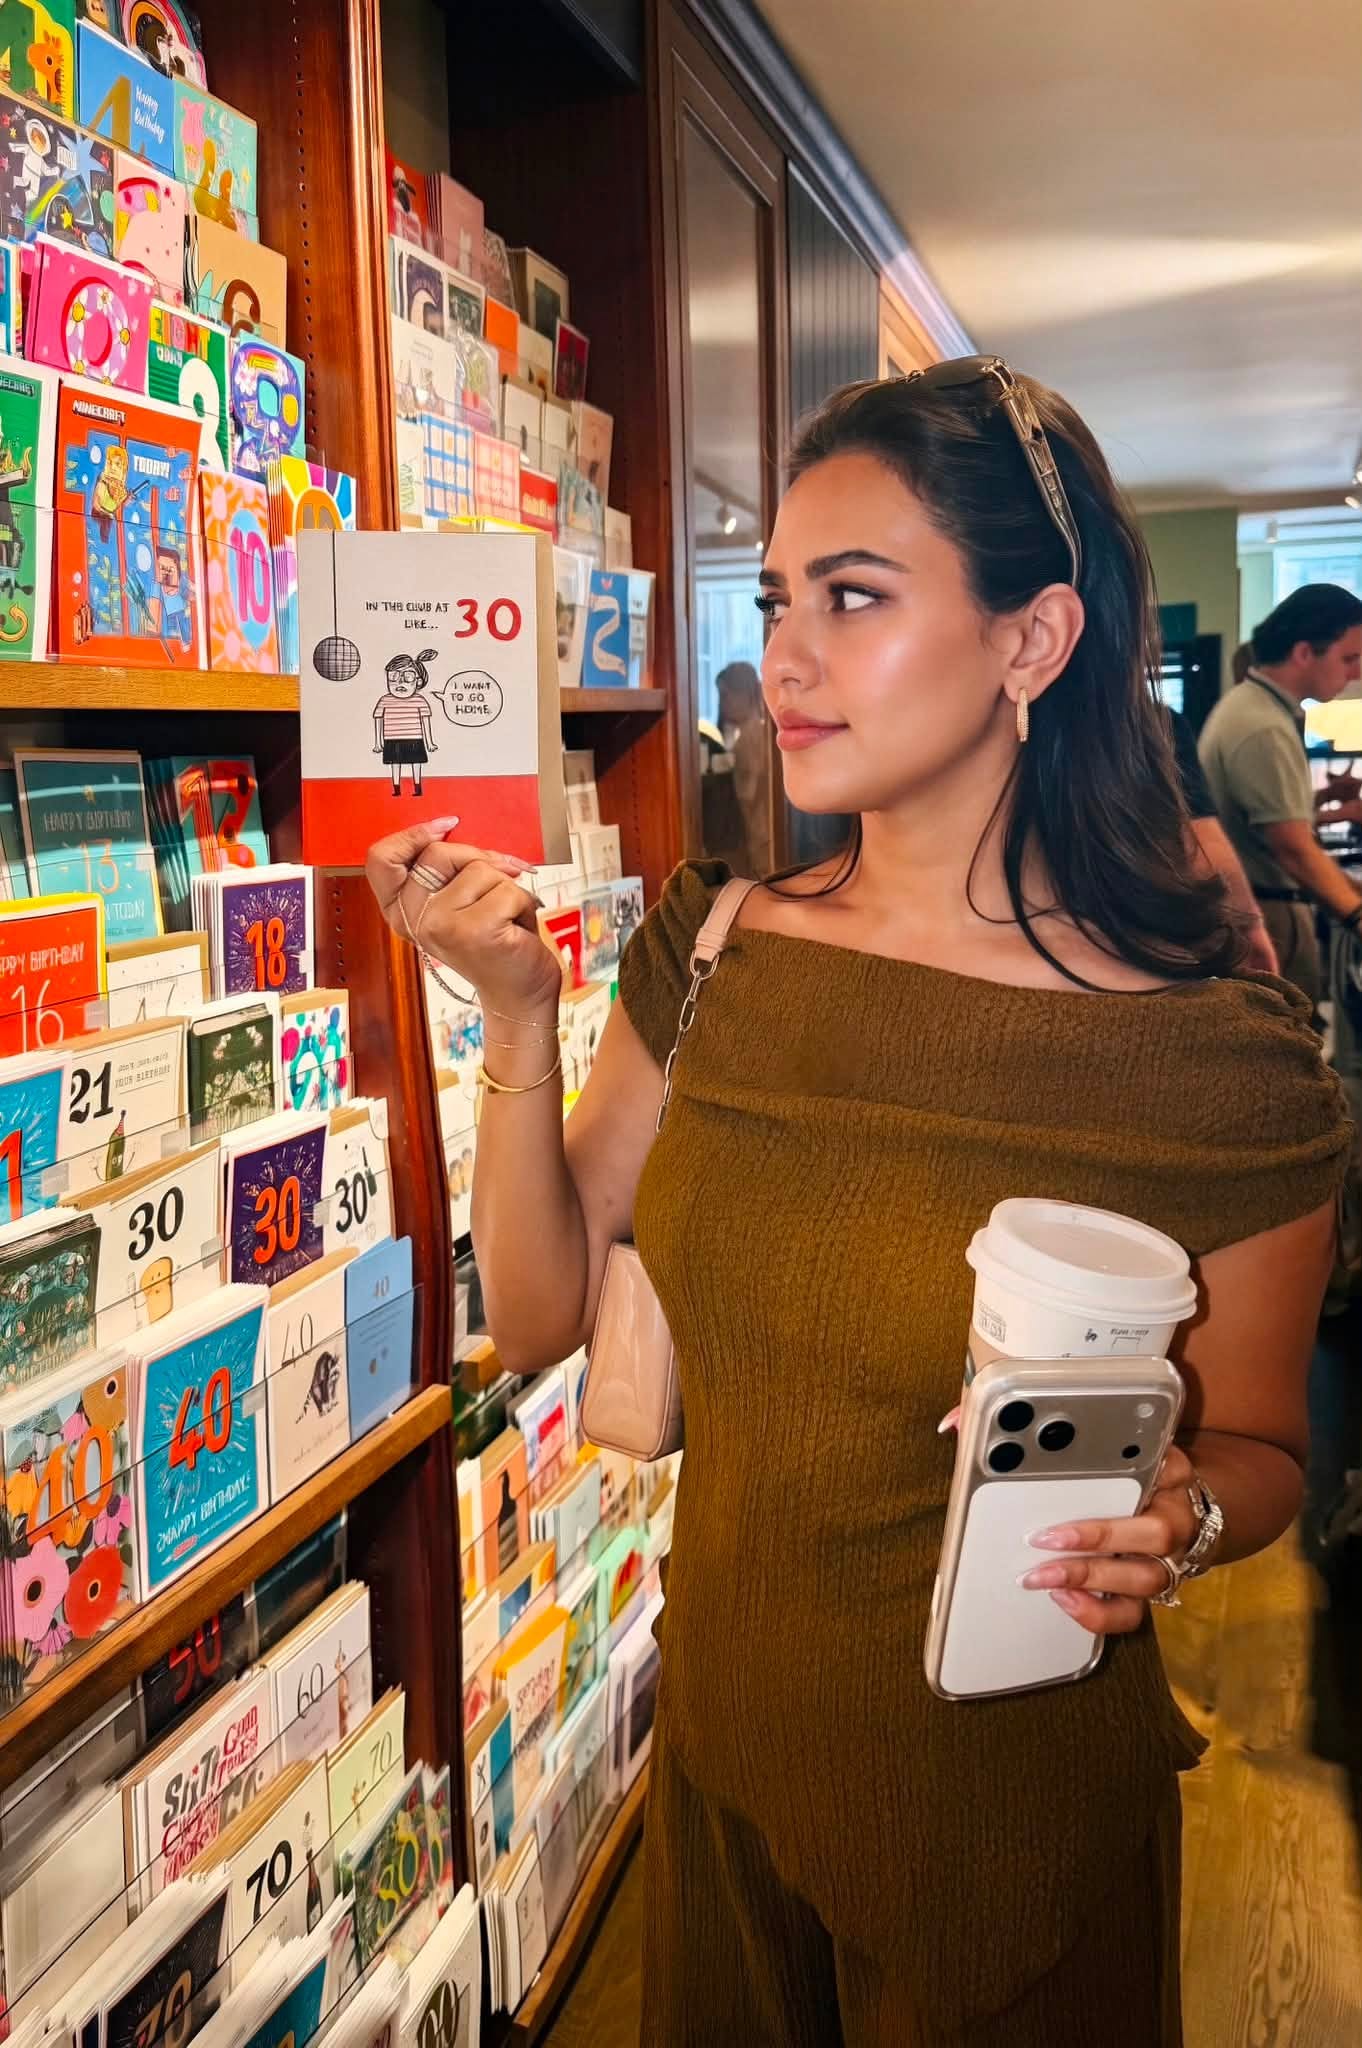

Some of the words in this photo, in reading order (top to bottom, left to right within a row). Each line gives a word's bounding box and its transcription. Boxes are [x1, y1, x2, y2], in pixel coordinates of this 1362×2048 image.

[134, 107, 166, 145] Birthday
[135, 86, 160, 117] Happy
[72, 399, 127, 427] MINECRAFT
[229, 526, 272, 625] 10
[366, 601, 378, 612] IN
[382, 601, 403, 613] THE
[406, 601, 432, 613] CLUB
[435, 602, 450, 613] AT
[454, 597, 522, 641] 30
[404, 619, 440, 630] LIKE...
[450, 692, 465, 702] TO
[468, 692, 485, 702] GO
[463, 681, 491, 691] WANT
[42, 811, 83, 833] HAPPY
[78, 838, 120, 894] 13
[115, 900, 145, 922] TODAY
[0, 953, 26, 977] PPY
[30, 942, 85, 972] BIRTHDAY
[245, 917, 287, 992] 18
[11, 979, 64, 1053] 16
[69, 1060, 114, 1124] 21
[128, 1186, 184, 1261] 30
[254, 1175, 301, 1265] 30
[335, 1172, 368, 1234] 30
[280, 1311, 314, 1368] 40
[168, 1366, 232, 1471] 40
[297, 1662, 324, 1719] 60
[370, 1730, 392, 1781] 70
[246, 1839, 293, 1925] 70
